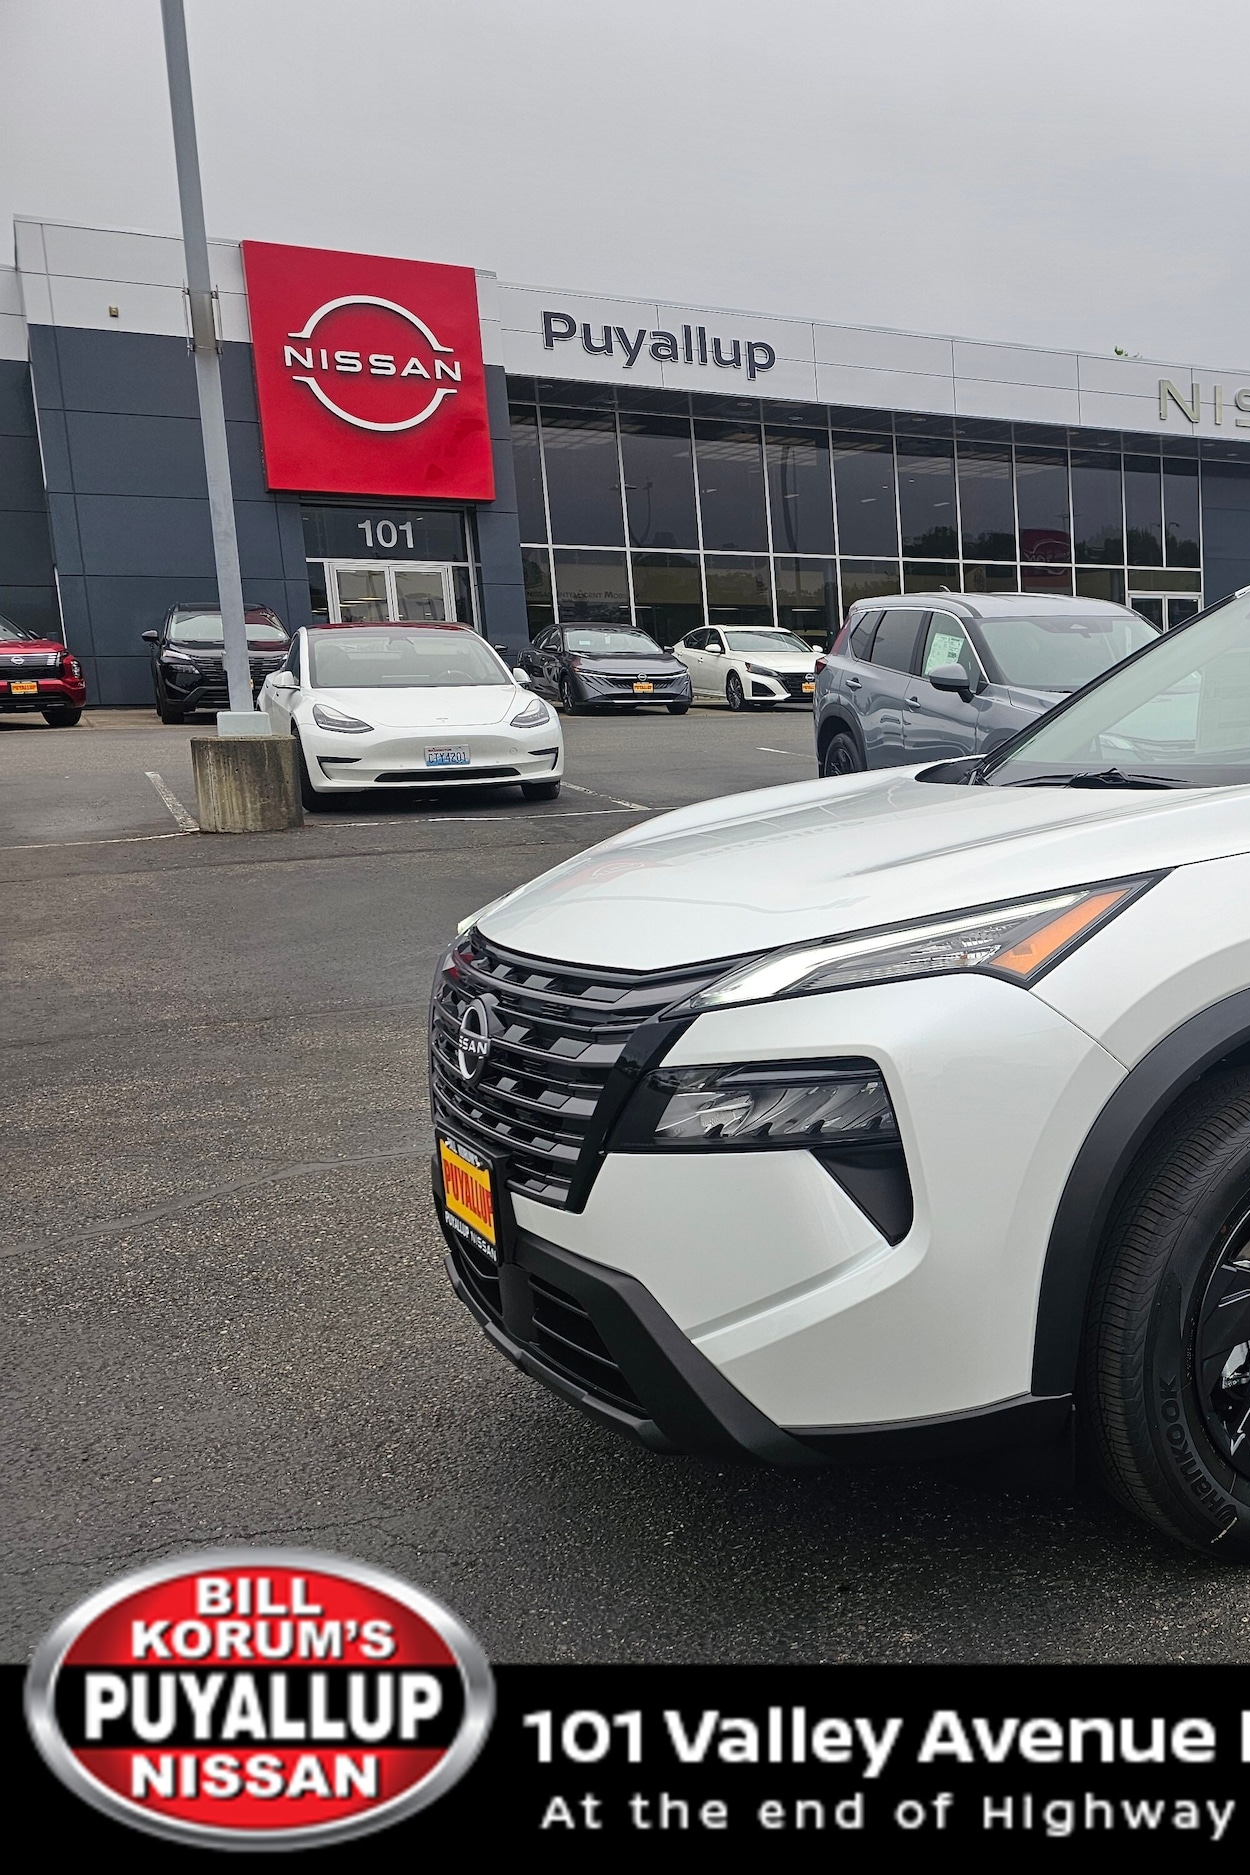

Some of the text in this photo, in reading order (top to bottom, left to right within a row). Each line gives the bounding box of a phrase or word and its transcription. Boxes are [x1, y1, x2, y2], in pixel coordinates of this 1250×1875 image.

[284, 344, 462, 383] NISSAN
[542, 310, 776, 380] Puyallup
[357, 518, 416, 549] 101
[459, 1035, 488, 1055] SSAN
[443, 1158, 494, 1228] PUYALLUP
